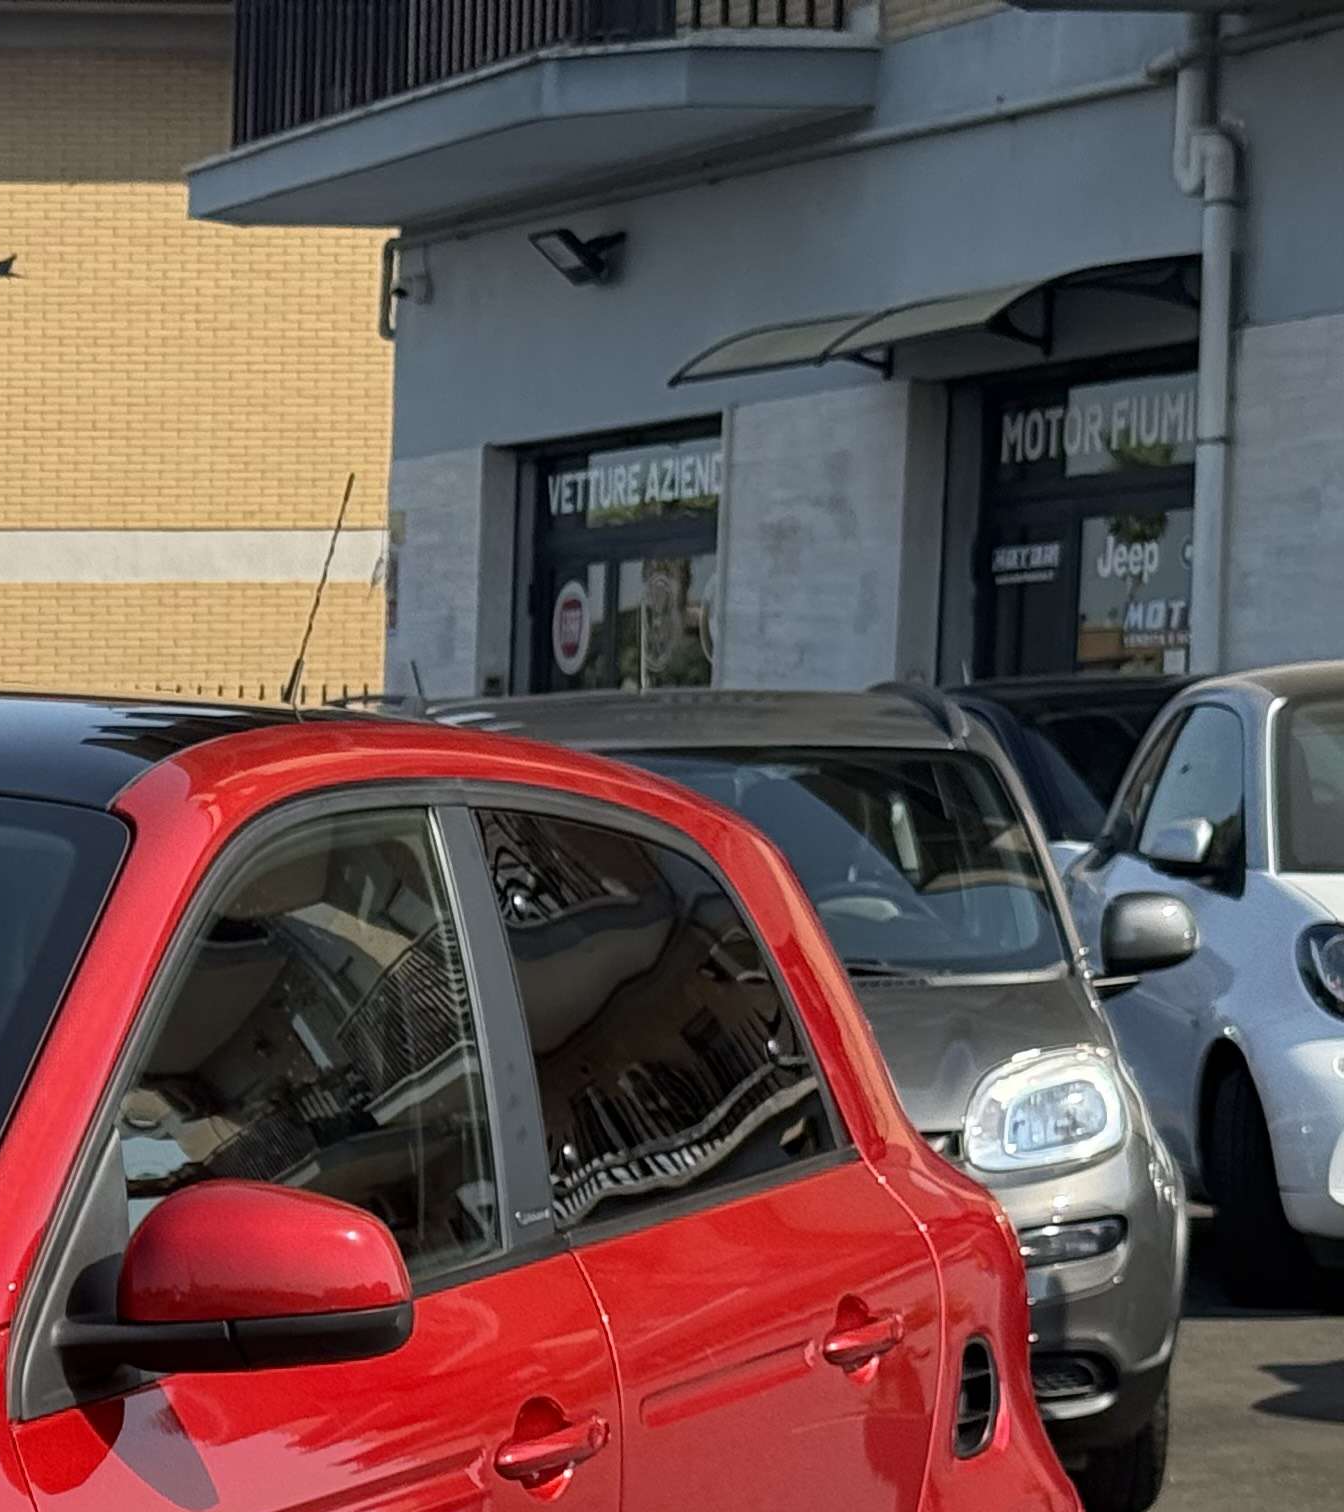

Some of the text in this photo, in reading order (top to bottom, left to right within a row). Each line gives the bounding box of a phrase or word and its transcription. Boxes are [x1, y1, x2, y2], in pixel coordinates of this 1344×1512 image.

[1000, 403, 1104, 464] MOTOR
[547, 463, 642, 516] VETTURE
[1097, 535, 1160, 583] Jeep
